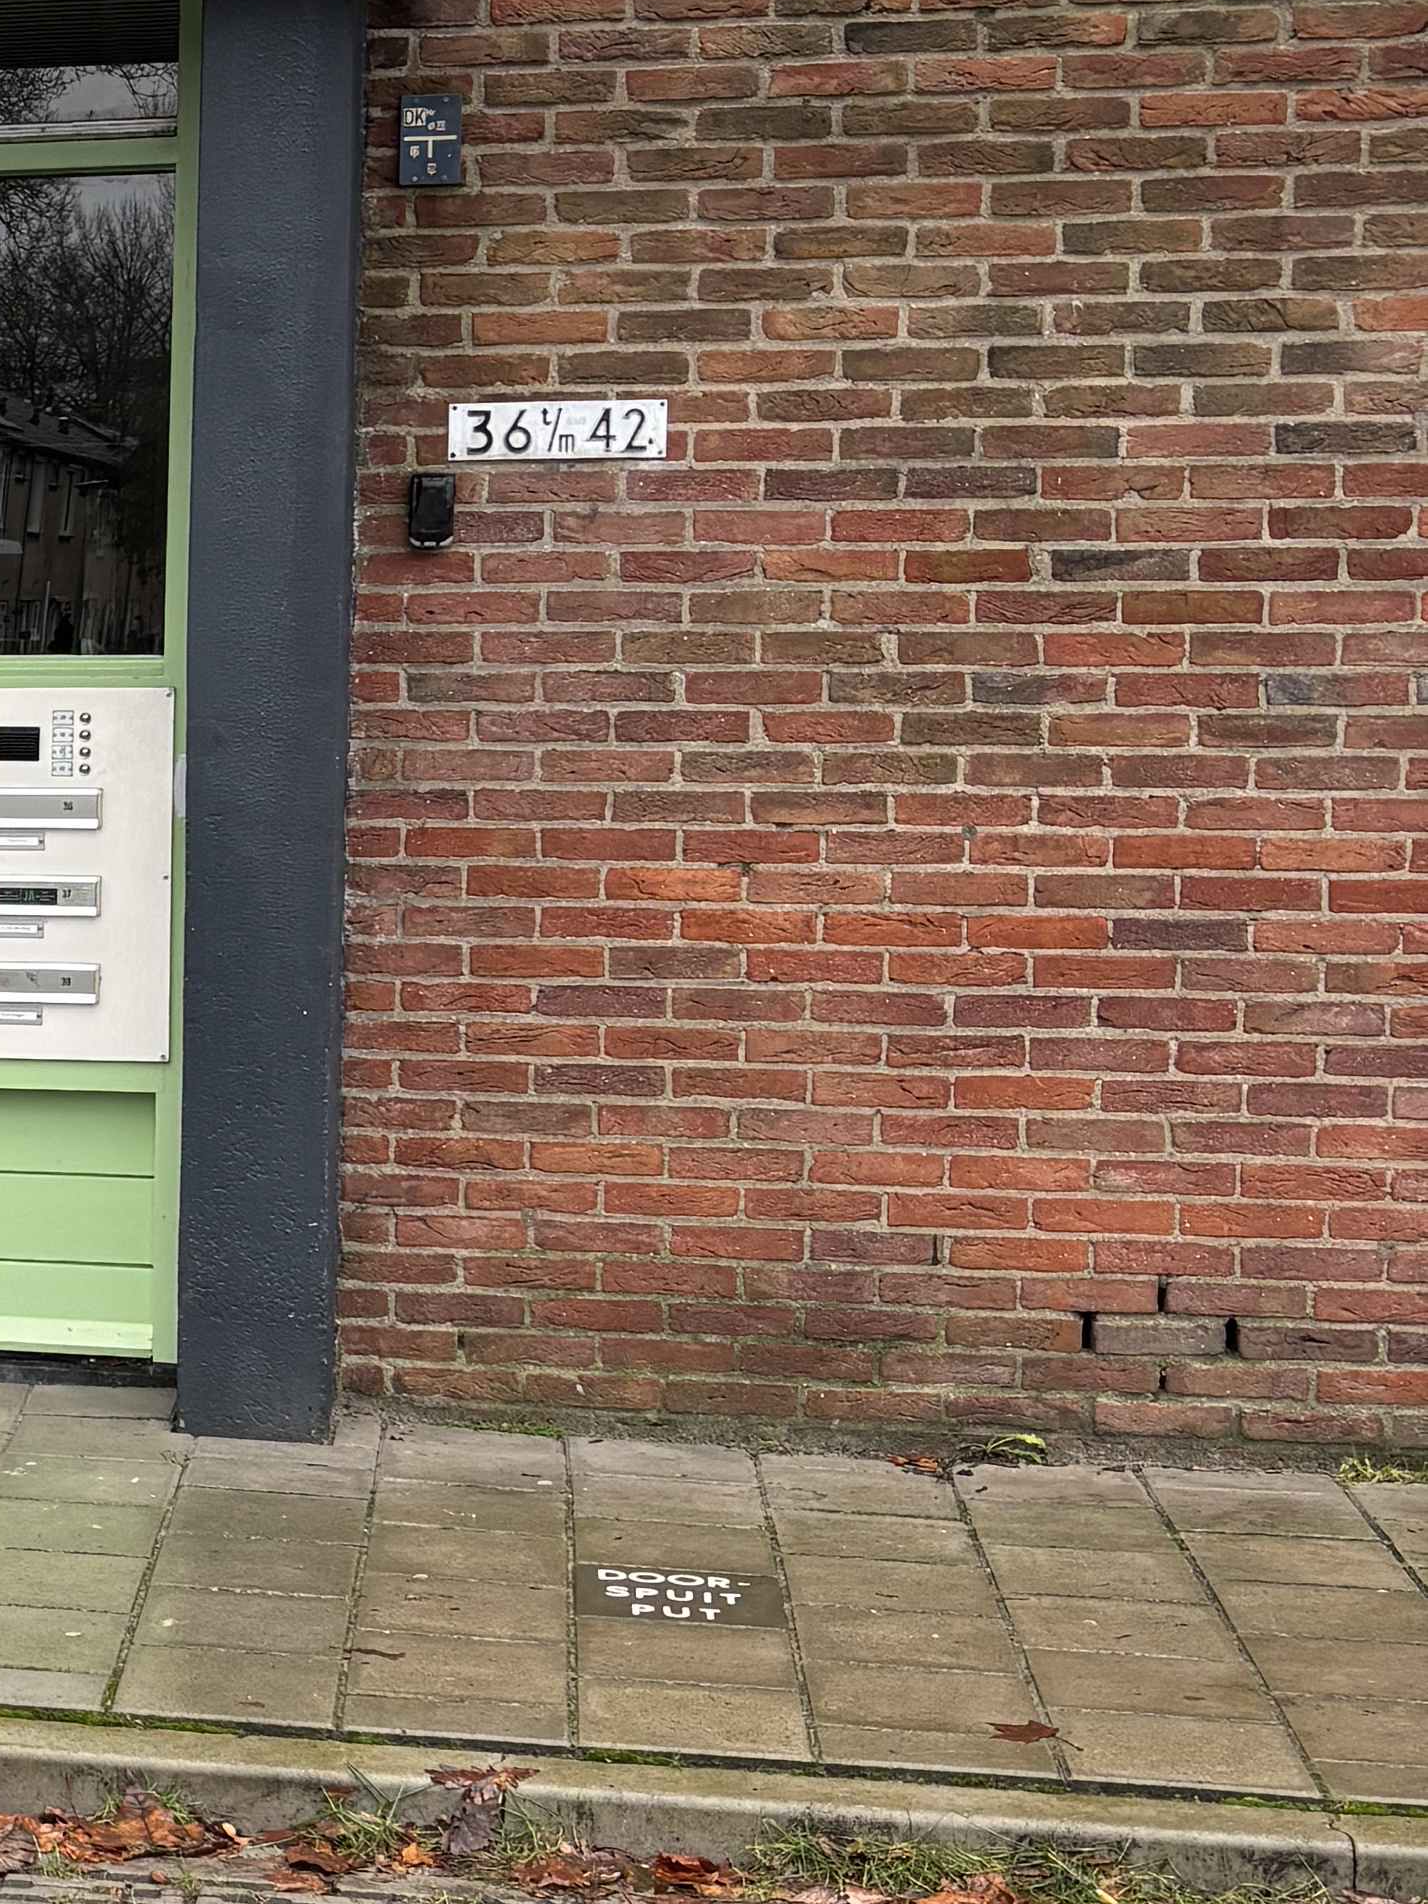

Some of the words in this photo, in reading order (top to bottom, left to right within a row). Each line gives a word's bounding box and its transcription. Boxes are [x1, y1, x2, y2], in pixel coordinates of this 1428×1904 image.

[467, 409, 532, 456] 36
[542, 407, 575, 453] t/m
[586, 407, 648, 453] 42
[597, 1568, 751, 1590] DOOR-
[605, 1585, 742, 1606] SPUIT
[631, 1603, 721, 1621] PUT
